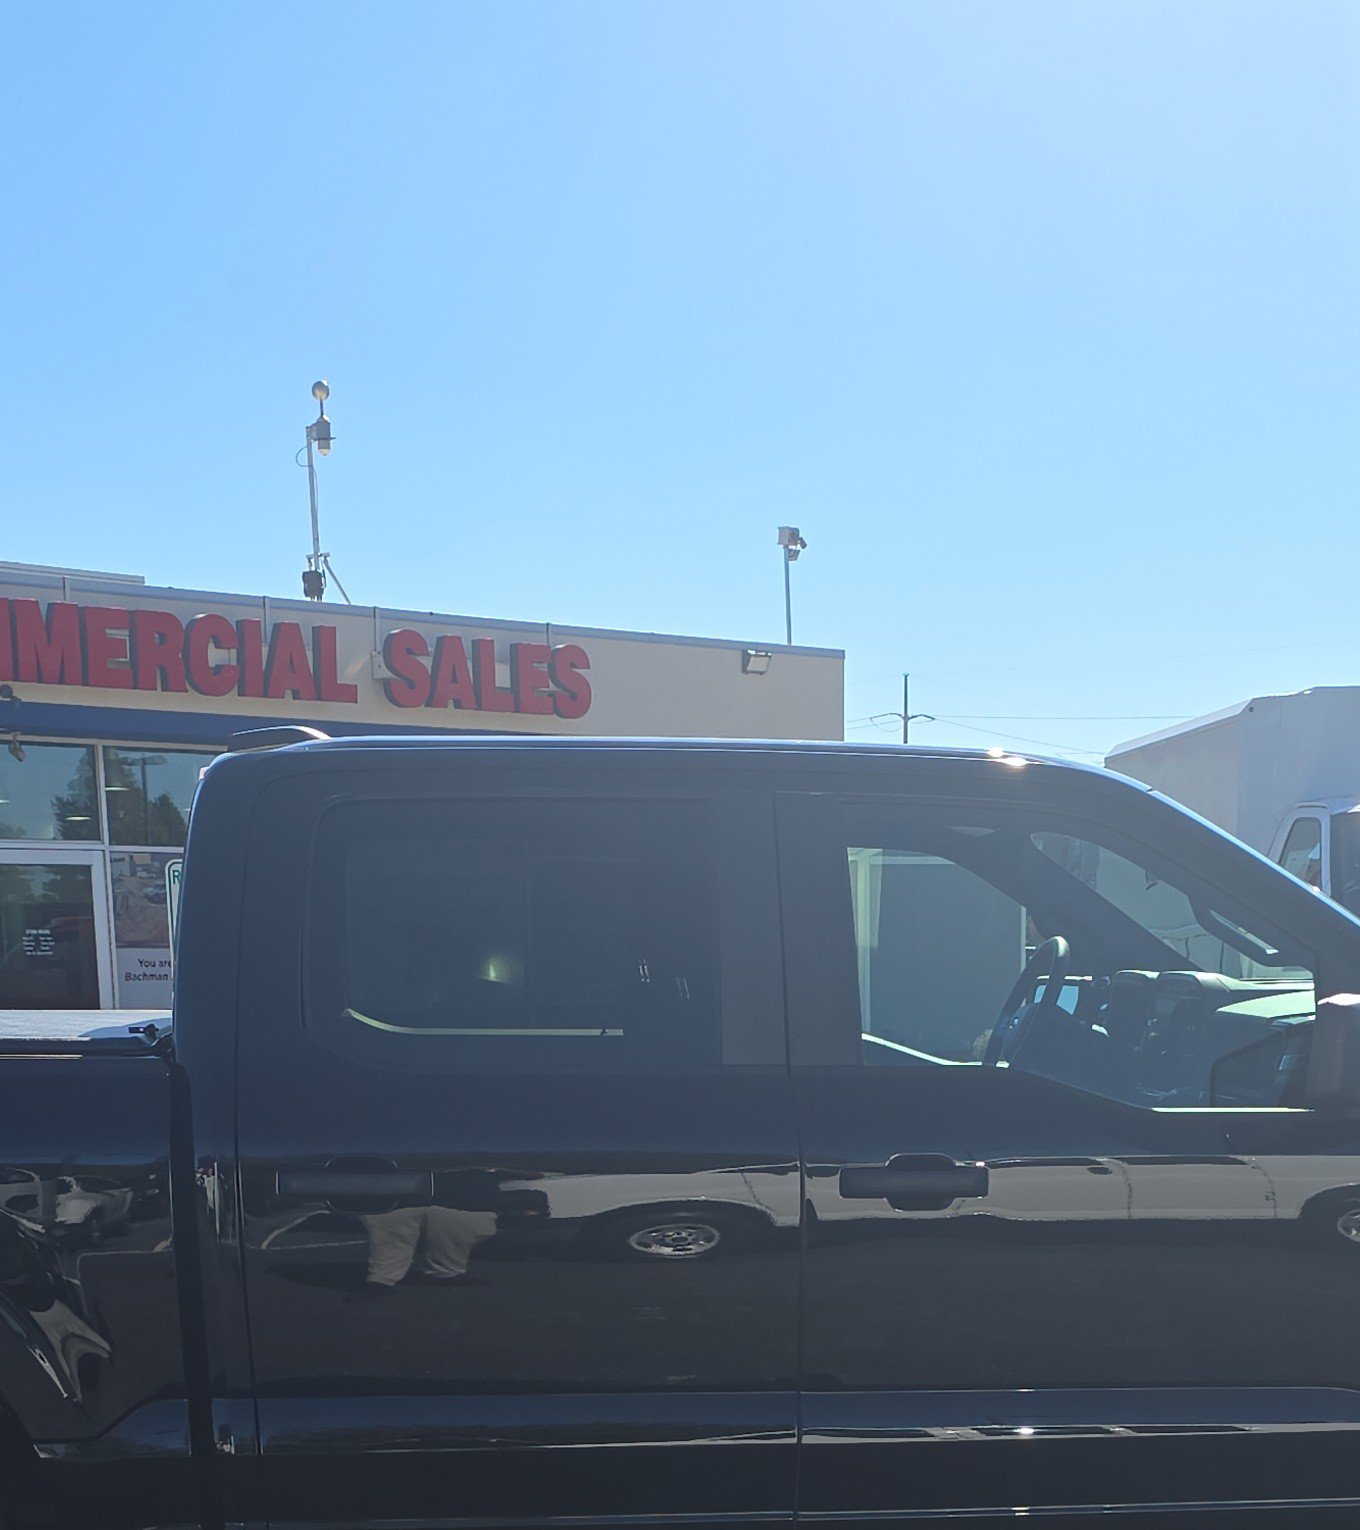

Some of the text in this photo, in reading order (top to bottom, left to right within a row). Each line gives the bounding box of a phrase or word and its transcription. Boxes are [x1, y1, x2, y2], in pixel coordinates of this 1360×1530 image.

[383, 628, 592, 719] SALES
[138, 958, 156, 968] You
[125, 971, 168, 981] Bachman
